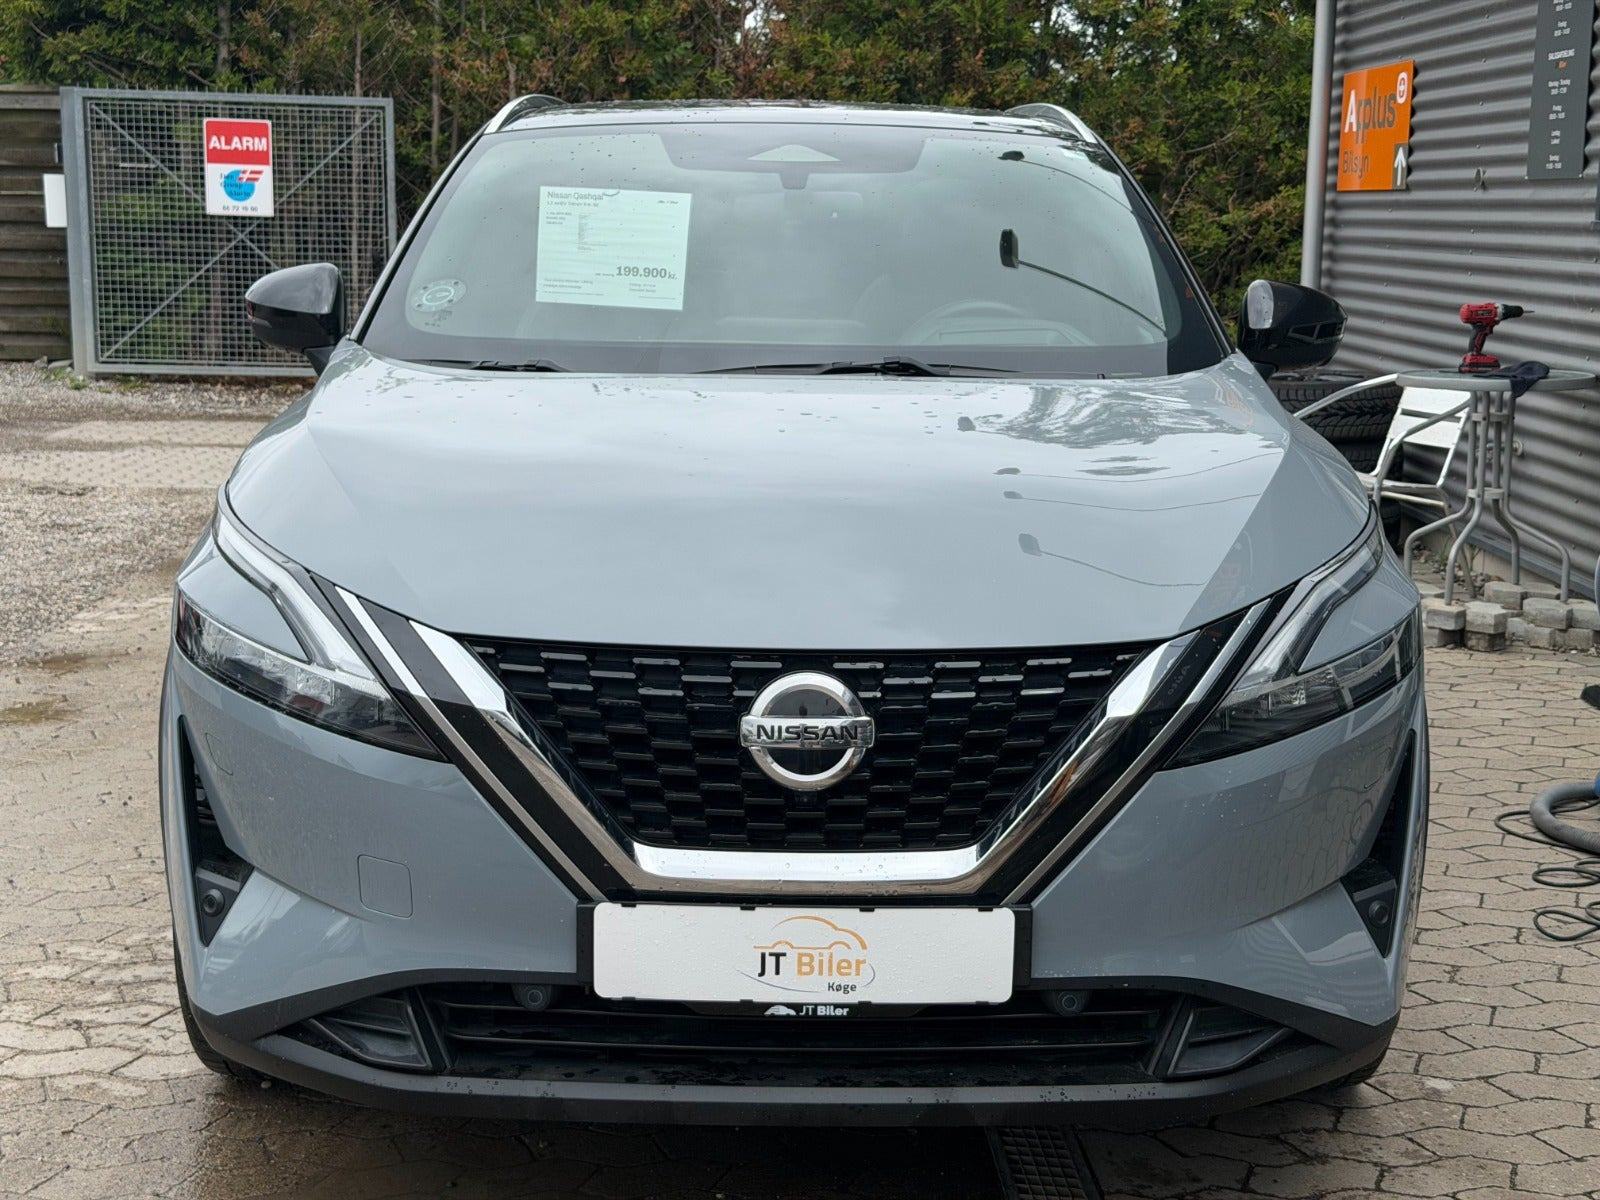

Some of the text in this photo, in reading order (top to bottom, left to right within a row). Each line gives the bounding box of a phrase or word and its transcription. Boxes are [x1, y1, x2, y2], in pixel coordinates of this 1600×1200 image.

[208, 135, 268, 152] ALARM
[1342, 150, 1370, 179] Bilsyn
[547, 191, 572, 199] Nissan
[616, 266, 667, 278] 199.900
[667, 271, 678, 280] kr.
[756, 724, 858, 741] NISSAN
[757, 952, 867, 977] JT Biler
[827, 982, 857, 995] Køge
[800, 1004, 850, 1016] JT Biler
